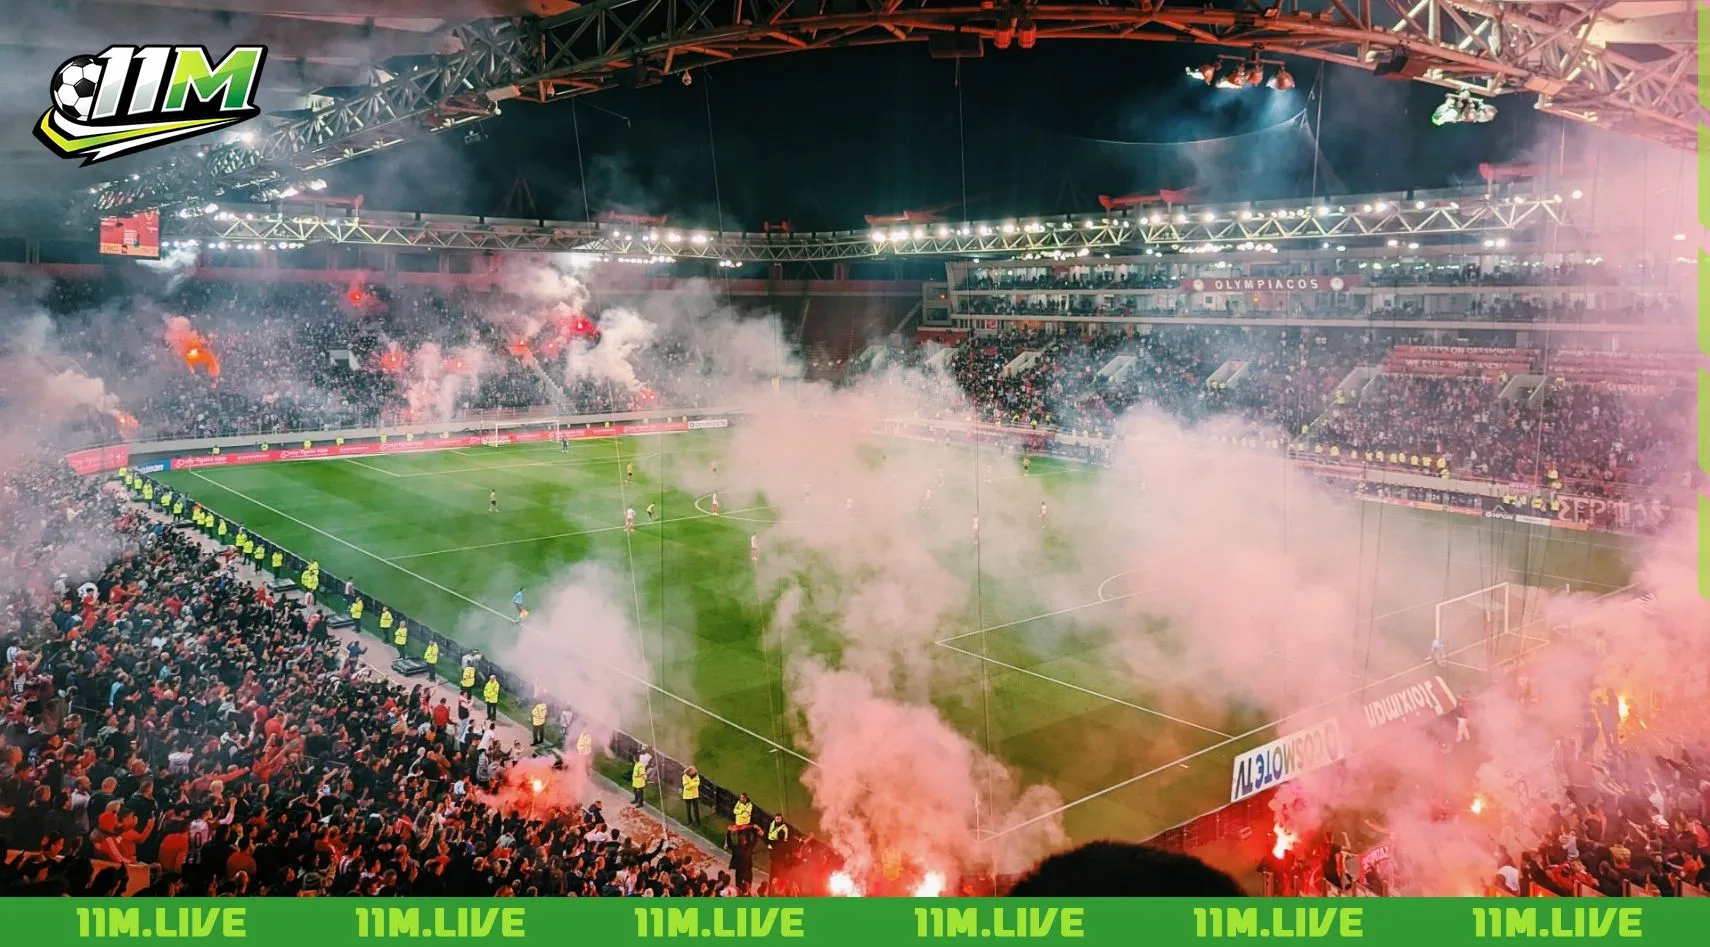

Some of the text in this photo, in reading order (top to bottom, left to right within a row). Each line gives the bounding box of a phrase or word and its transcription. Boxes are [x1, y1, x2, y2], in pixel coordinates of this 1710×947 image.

[1214, 279, 1319, 290] OLYMPIACOS
[1234, 729, 1322, 800] COSMOTE TV
